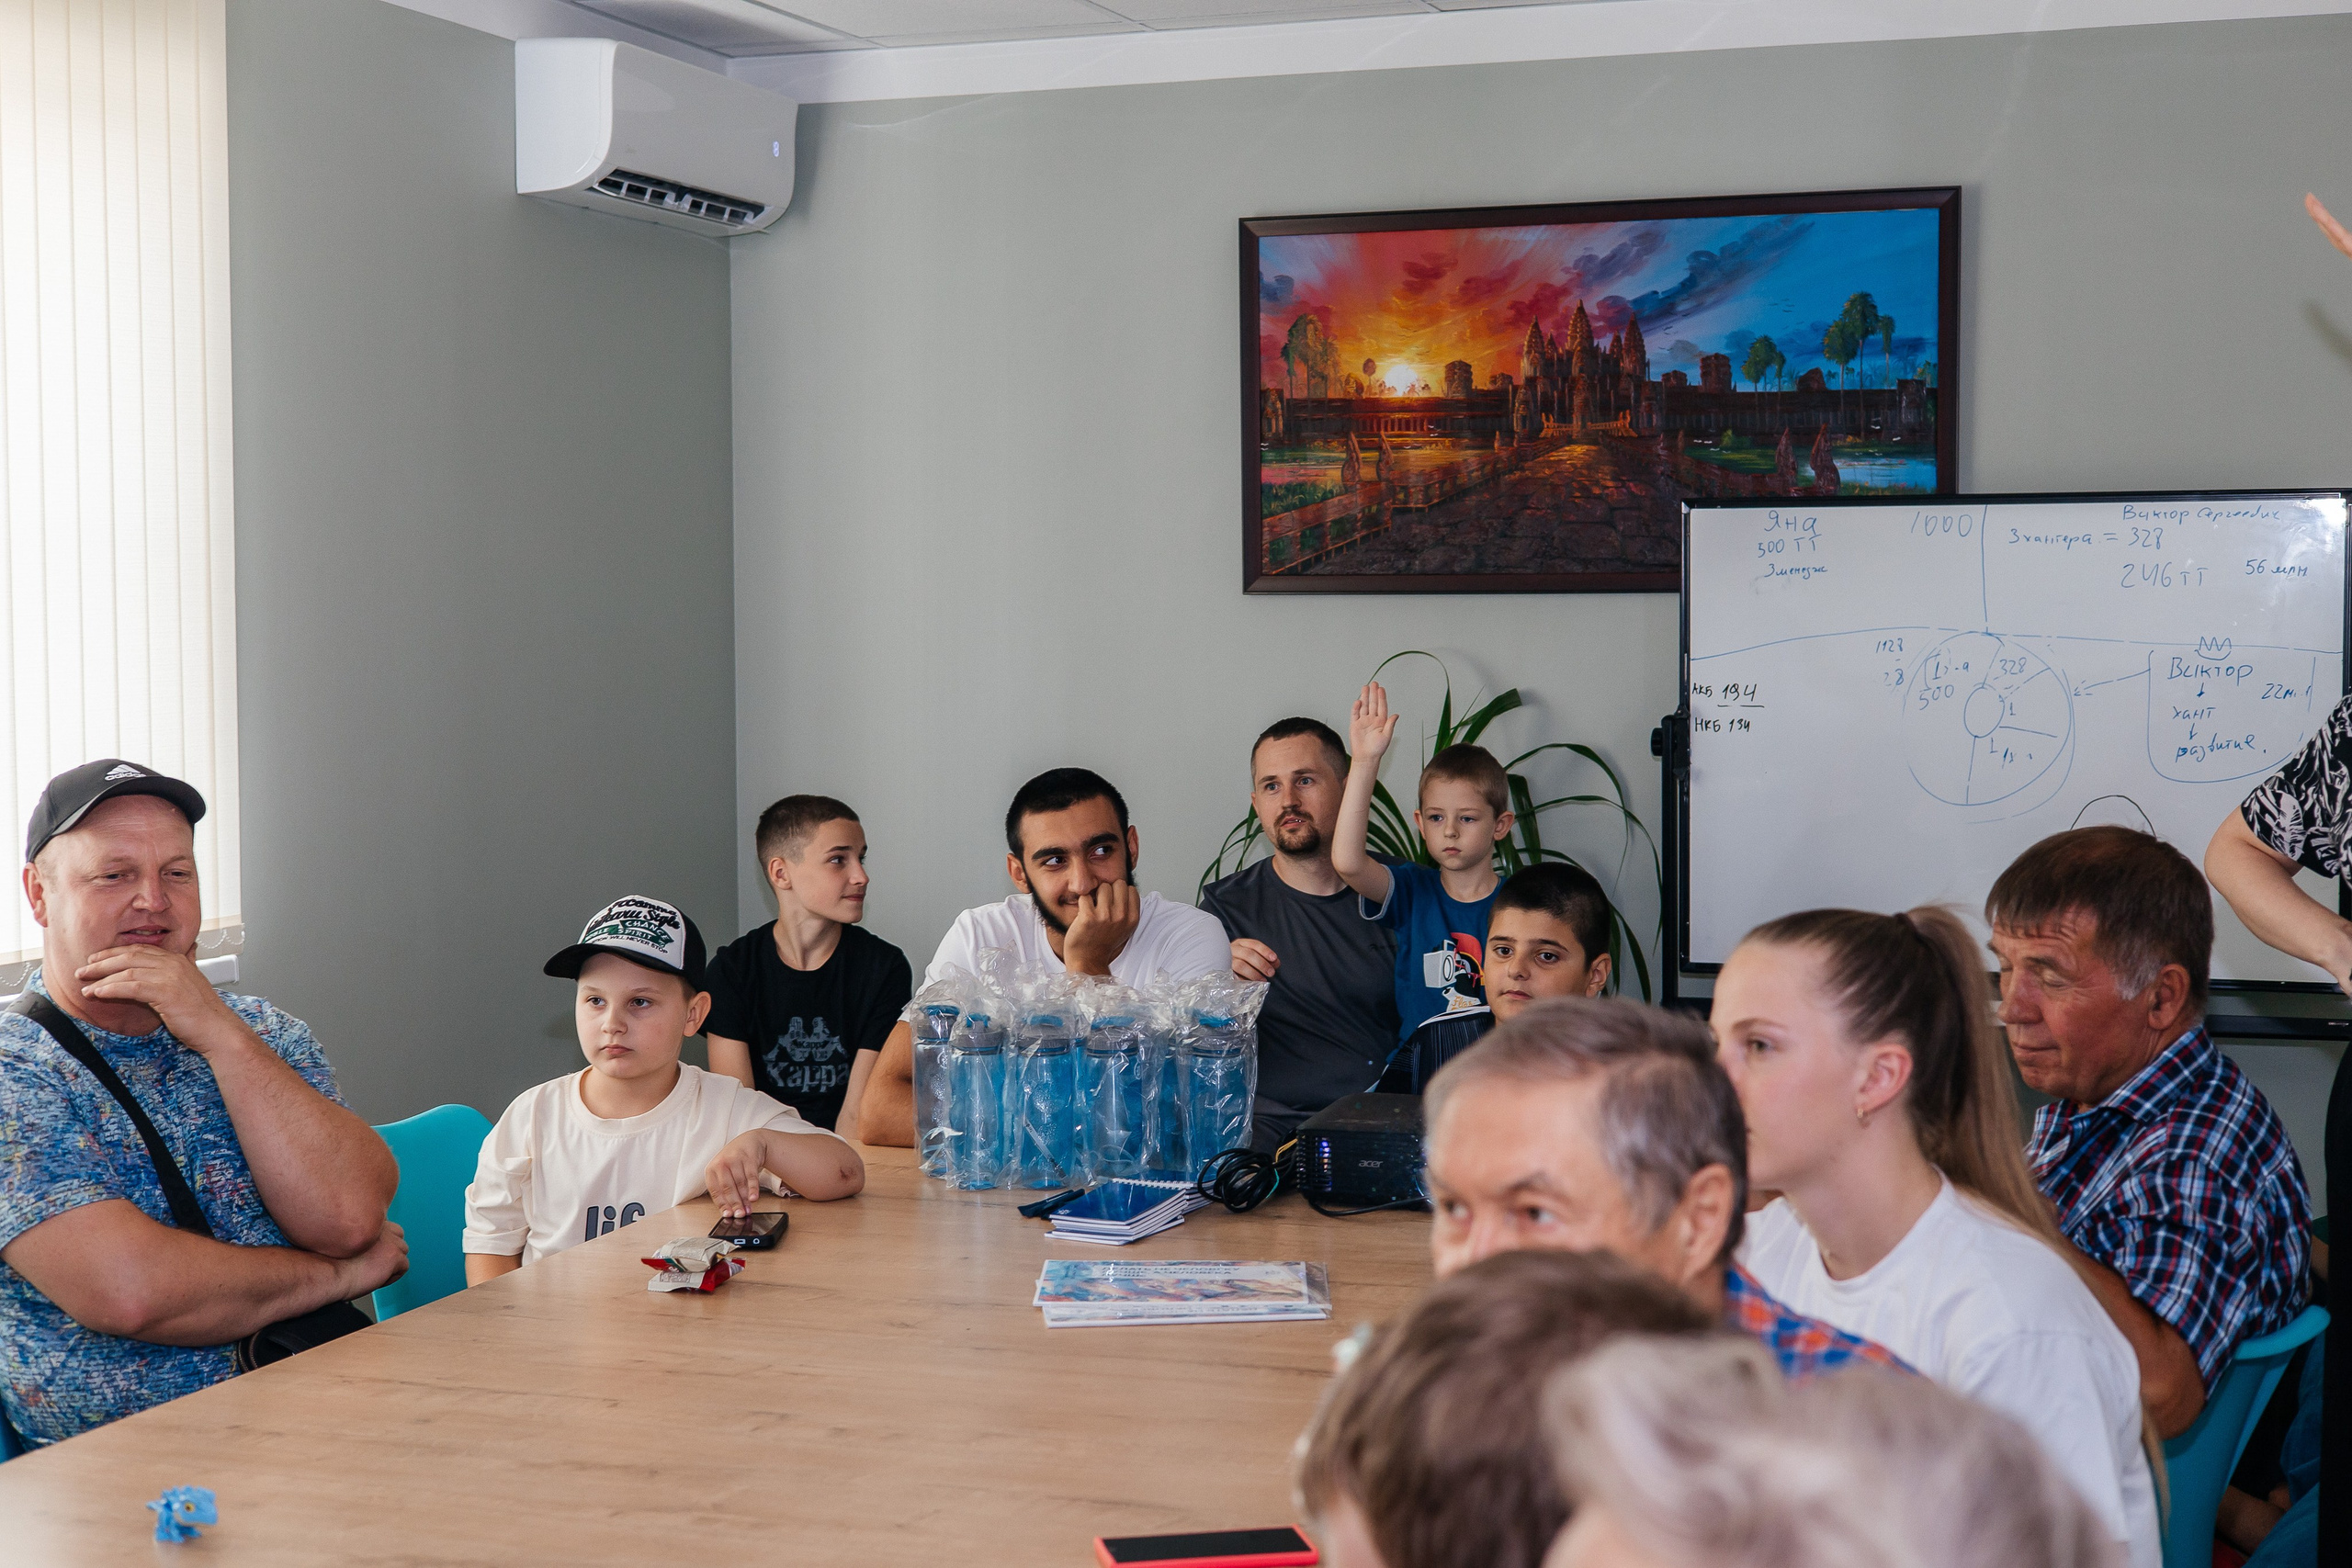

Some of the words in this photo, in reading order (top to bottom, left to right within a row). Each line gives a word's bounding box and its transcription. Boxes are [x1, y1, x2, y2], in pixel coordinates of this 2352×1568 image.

[1763, 509, 1818, 536] Яна
[1910, 511, 1973, 537] 1000
[1758, 538, 1785, 558] 500
[2245, 558, 2267, 576] 56
[617, 928, 653, 940] SPIRIT
[625, 919, 670, 941] CHANGE
[1358, 1159, 1384, 1168] acer
